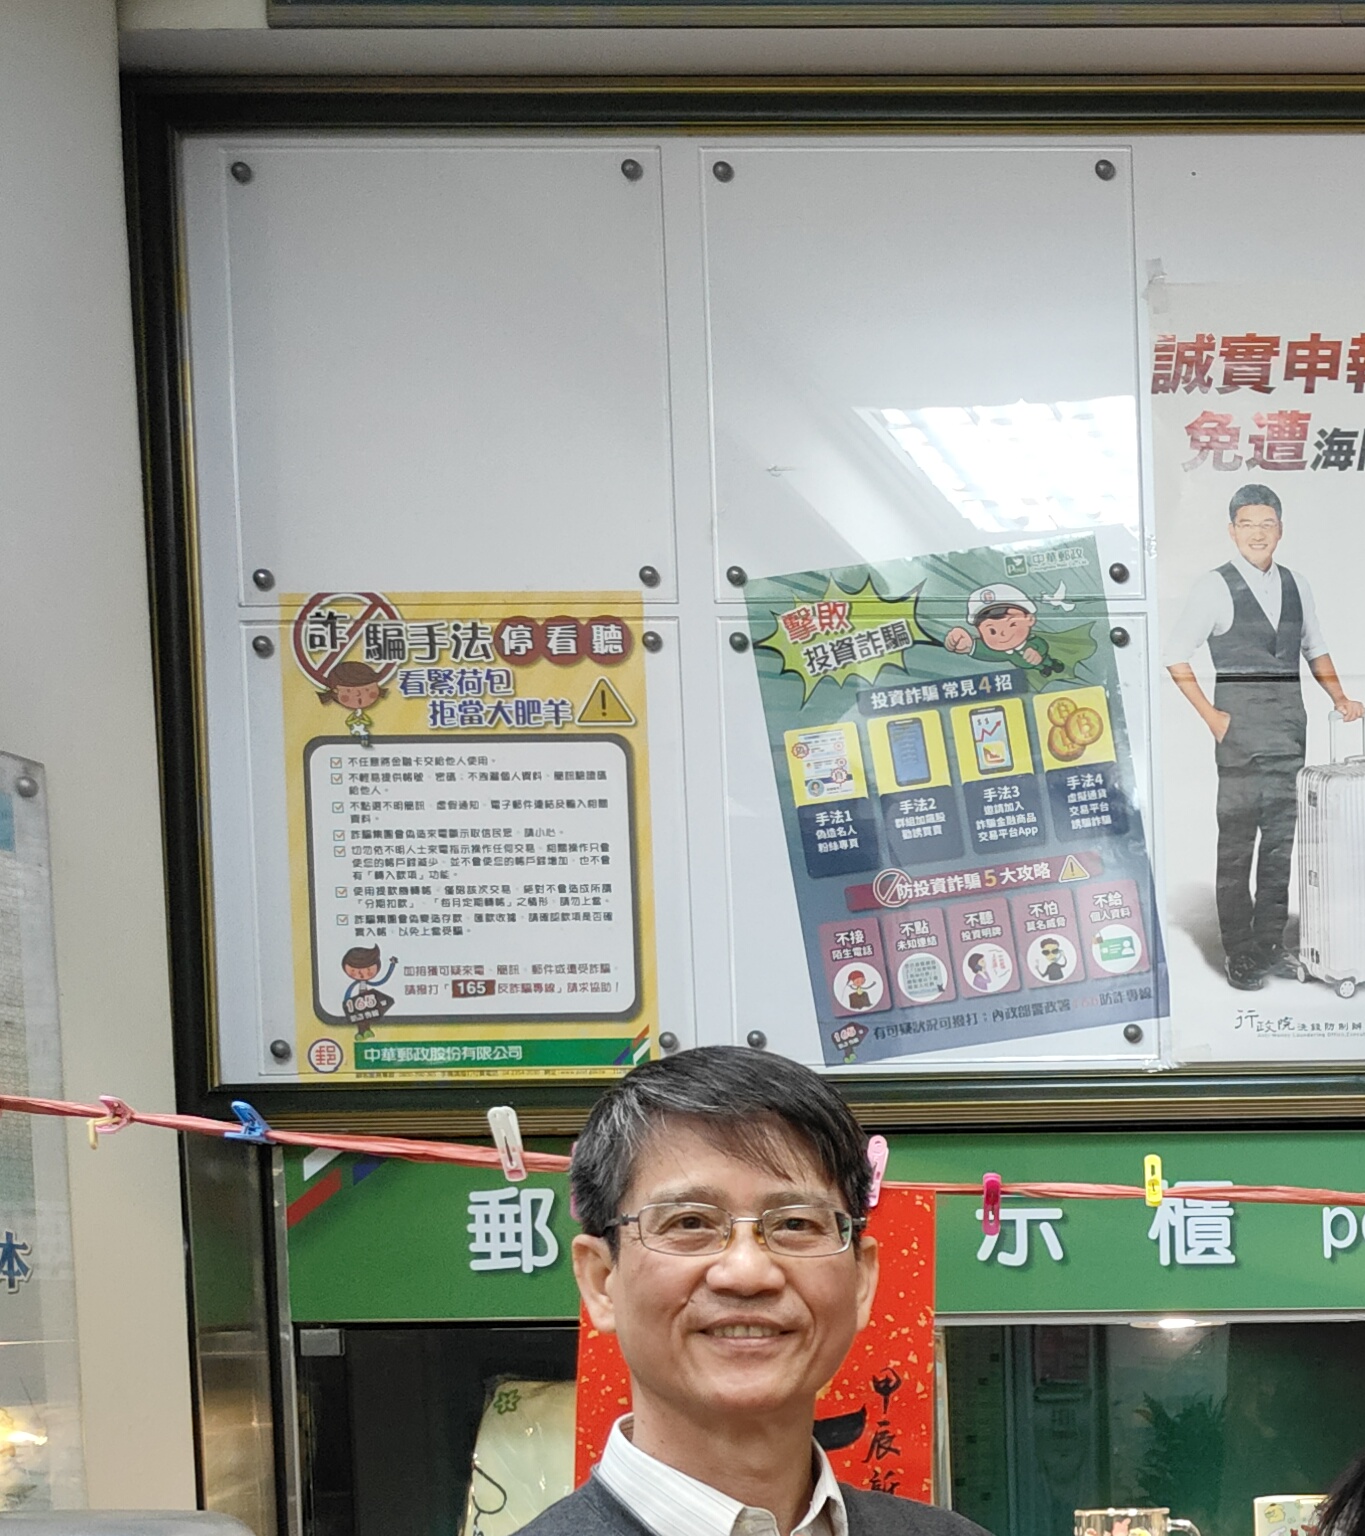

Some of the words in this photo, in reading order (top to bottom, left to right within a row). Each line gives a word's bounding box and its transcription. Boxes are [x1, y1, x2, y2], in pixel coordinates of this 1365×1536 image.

[781, 600, 851, 642] 擊敗
[803, 619, 912, 675] 投資詐騙
[399, 668, 514, 697] 看緊荷包
[870, 684, 939, 710] 投資詐騙
[429, 698, 572, 728] 拒當大肥羊
[1065, 773, 1104, 790] 手法4
[983, 785, 1021, 803] 手法3
[899, 797, 937, 815] 手法2
[815, 809, 854, 826] 手法1
[1092, 890, 1124, 908] 不給
[1029, 900, 1060, 917] 不怕
[899, 919, 930, 936] 不點
[964, 910, 995, 927] 不聽
[835, 929, 866, 946] 不接
[364, 1045, 523, 1063] 中華郵政股份有限公司
